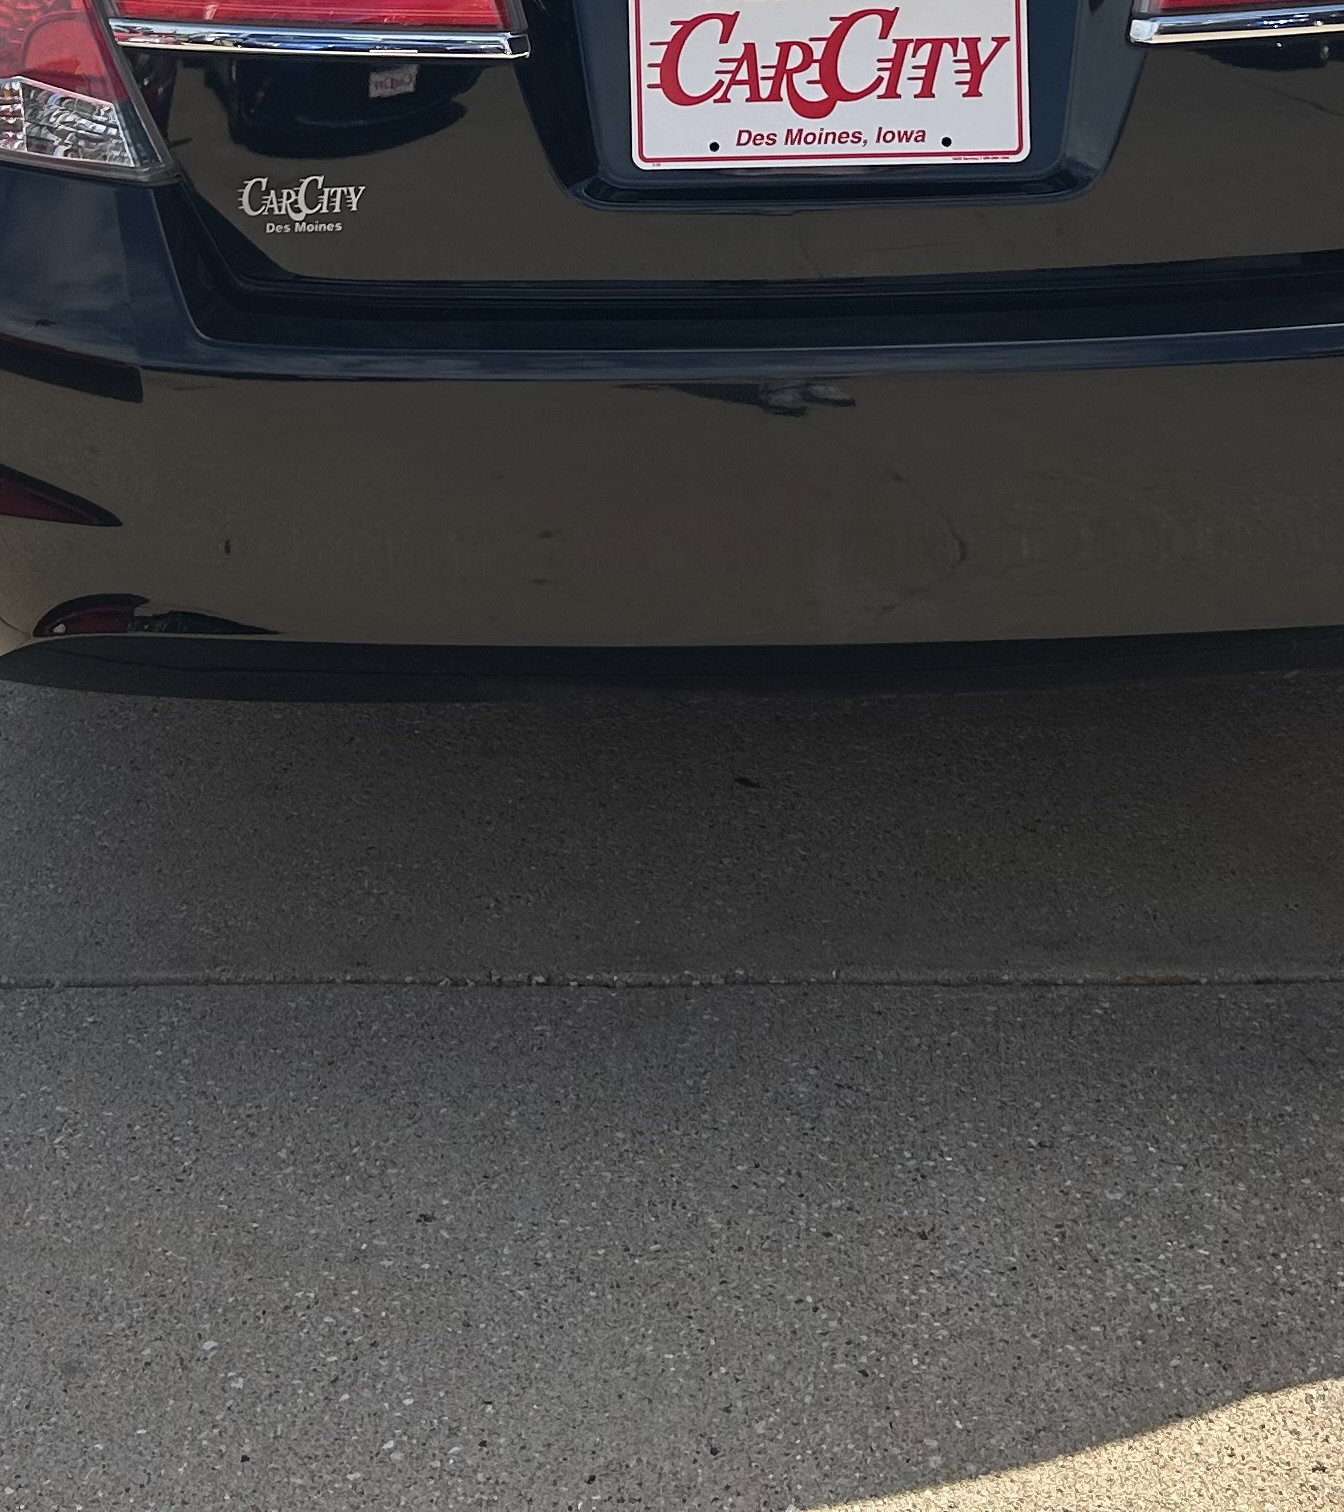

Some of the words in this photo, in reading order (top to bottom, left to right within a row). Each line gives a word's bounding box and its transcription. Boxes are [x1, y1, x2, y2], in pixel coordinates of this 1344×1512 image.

[735, 129, 778, 147] Des
[783, 127, 868, 148] Moines,
[875, 126, 927, 144] Iowa
[265, 222, 291, 233] Des
[294, 221, 343, 233] Moines
